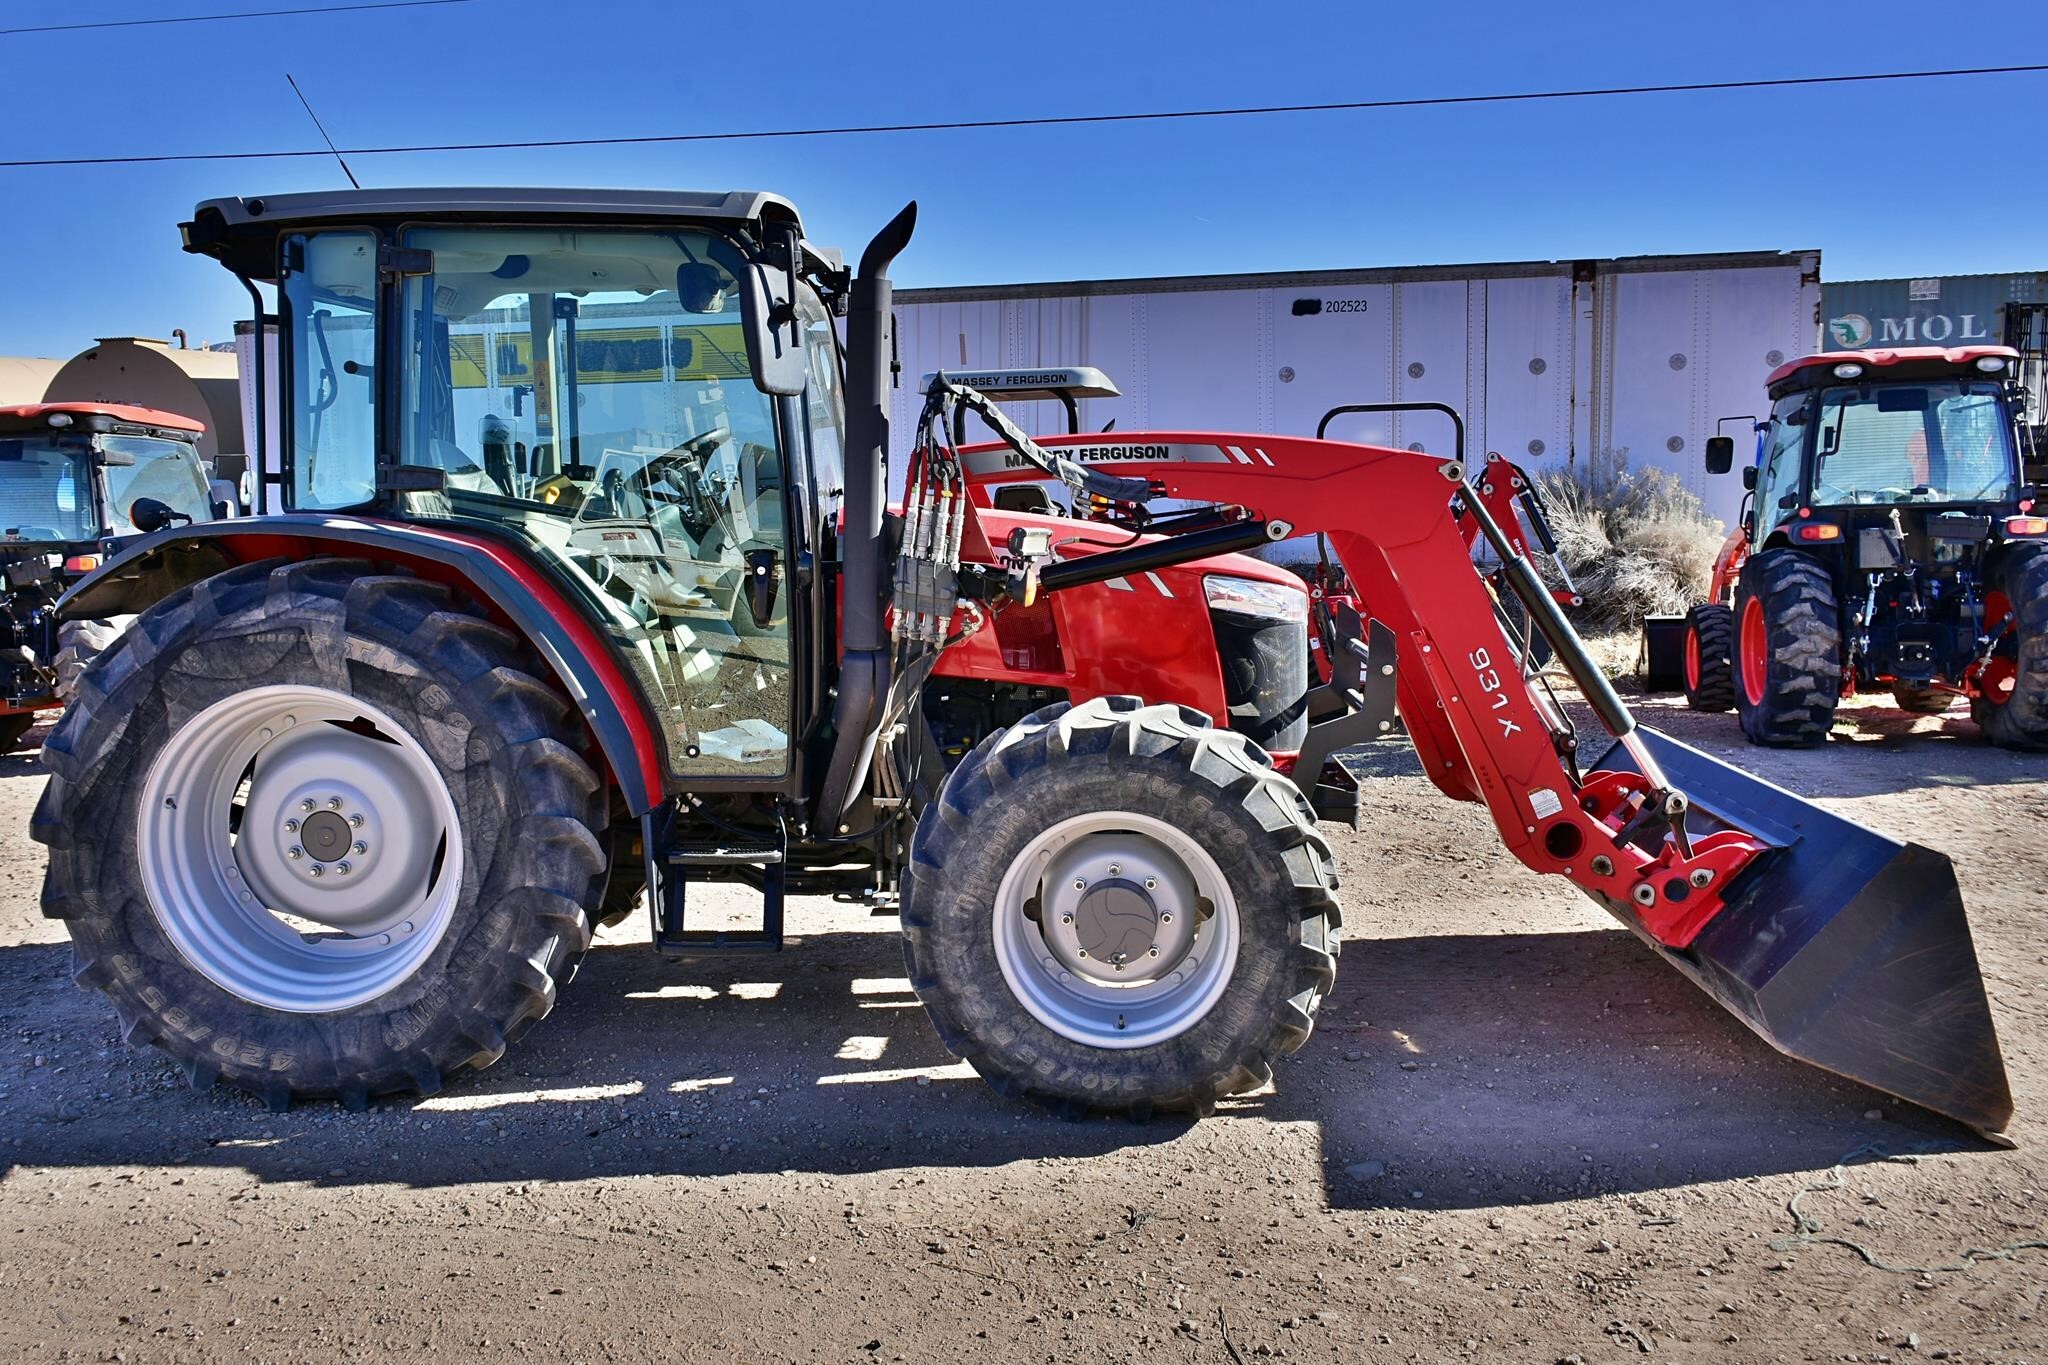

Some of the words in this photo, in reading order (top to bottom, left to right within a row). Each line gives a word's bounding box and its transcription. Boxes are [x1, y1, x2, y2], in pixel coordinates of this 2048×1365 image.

[1325, 300, 1368, 313] 202523
[1879, 314, 1987, 342] MOL
[951, 376, 1000, 387] MASSEY
[1006, 373, 1068, 385] FERGUSON
[1079, 445, 1170, 461] FERGUSON
[138, 985, 297, 1073] 420/85
